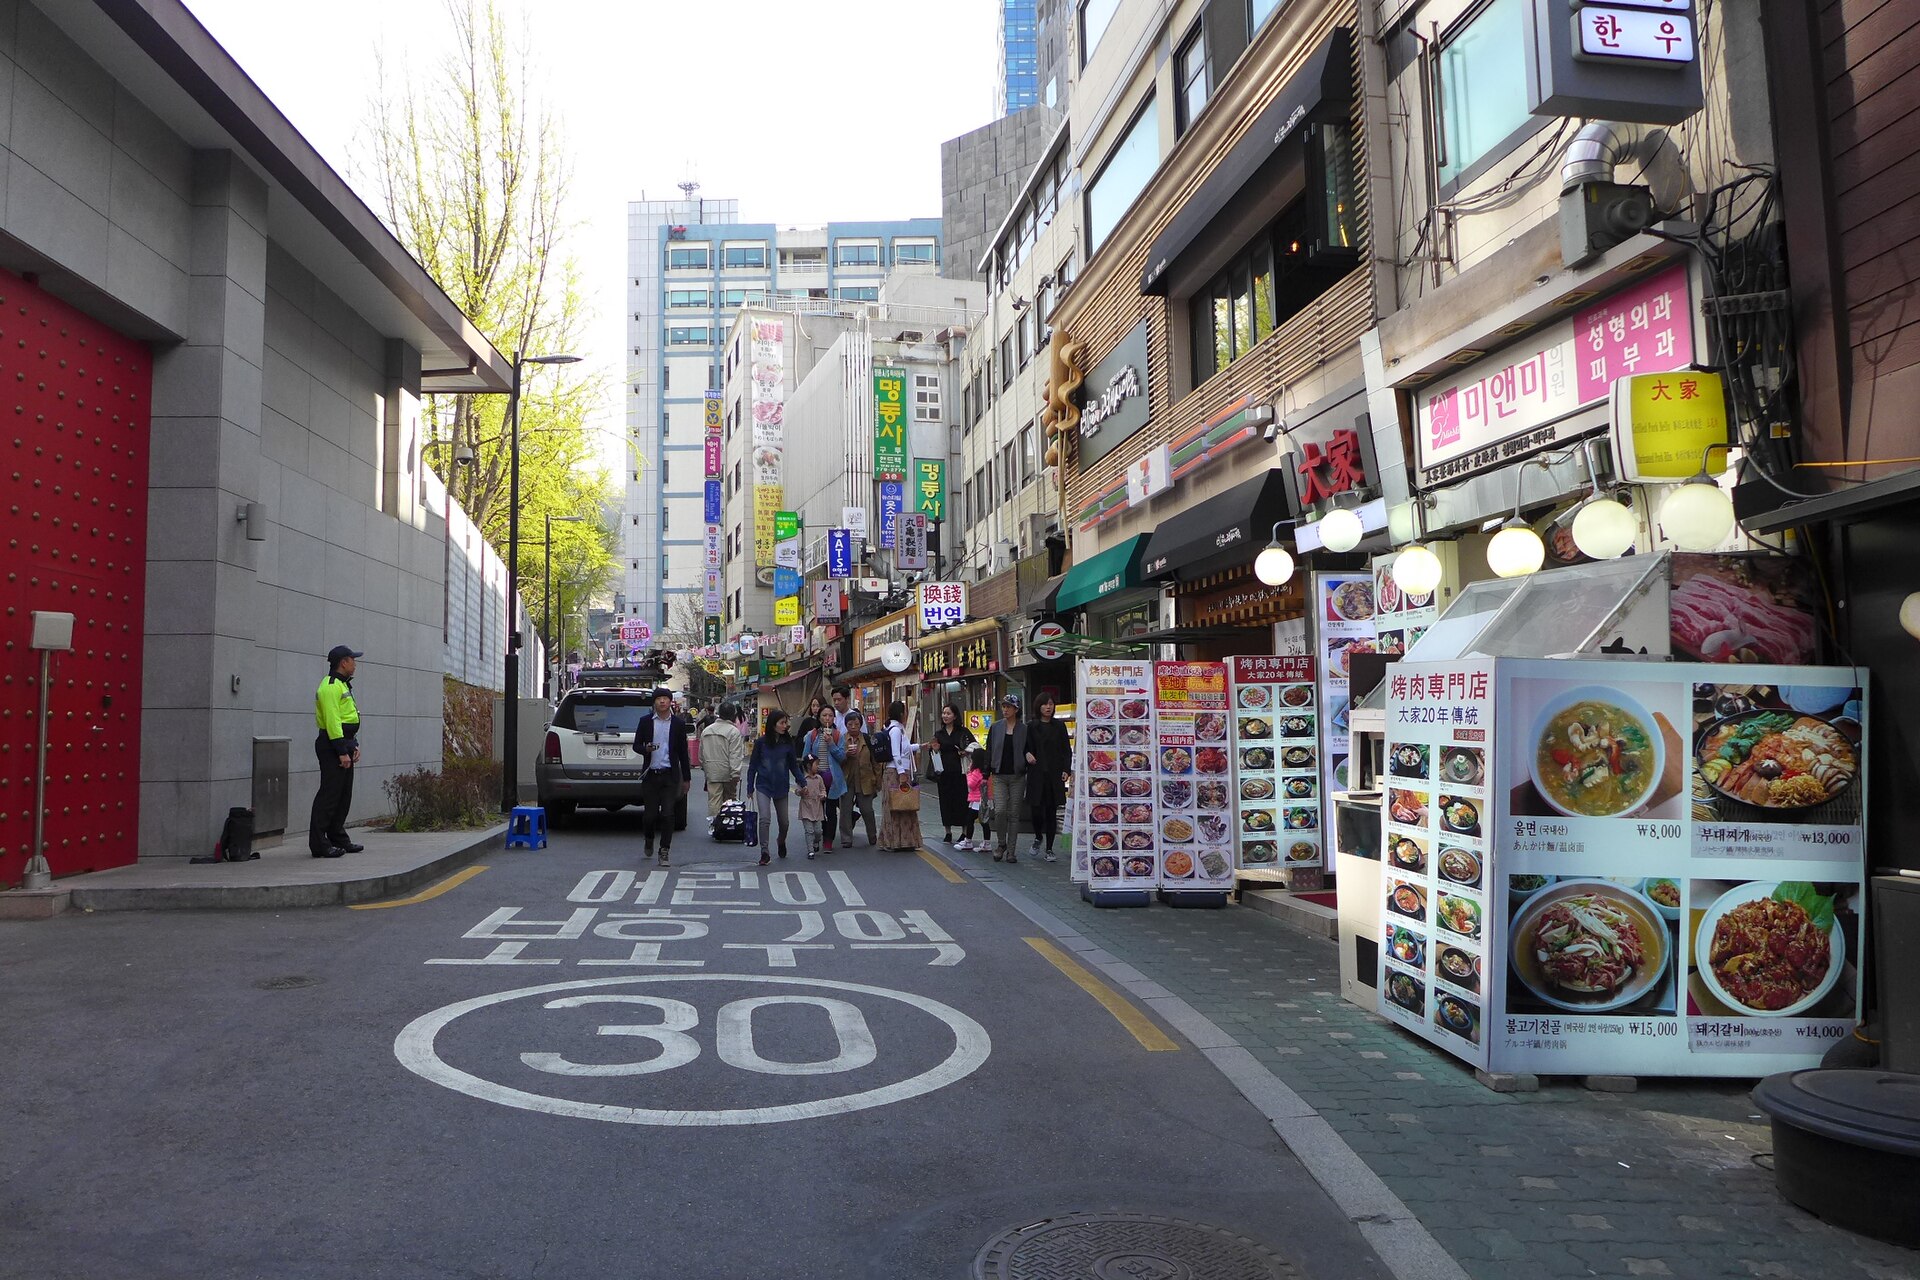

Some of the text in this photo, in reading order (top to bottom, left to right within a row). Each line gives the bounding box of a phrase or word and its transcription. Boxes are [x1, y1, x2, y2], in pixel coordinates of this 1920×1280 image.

[1592, 14, 1682, 54] 한우
[1588, 292, 1672, 352] 성형외과
[1550, 342, 1565, 397] 의원
[1590, 328, 1675, 383] 피부과
[1463, 351, 1548, 427] 미앤미
[1651, 379, 1700, 401] 大家
[879, 379, 903, 447] 명동사
[1298, 428, 1365, 505] 大家
[921, 463, 941, 517] 명동사
[885, 500, 896, 530] 옷수선
[835, 538, 844, 568] ATS
[923, 585, 962, 604] 換錢
[624, 628, 647, 639] 명품수선
[924, 606, 961, 625] 번역
[1514, 820, 1537, 837] 울면
[1539, 824, 1568, 836] (국내산)
[566, 870, 866, 906] 어린이
[424, 906, 966, 967] 보호구역
[520, 995, 877, 1076] 30
[1505, 1018, 1562, 1035] 불고기전골
